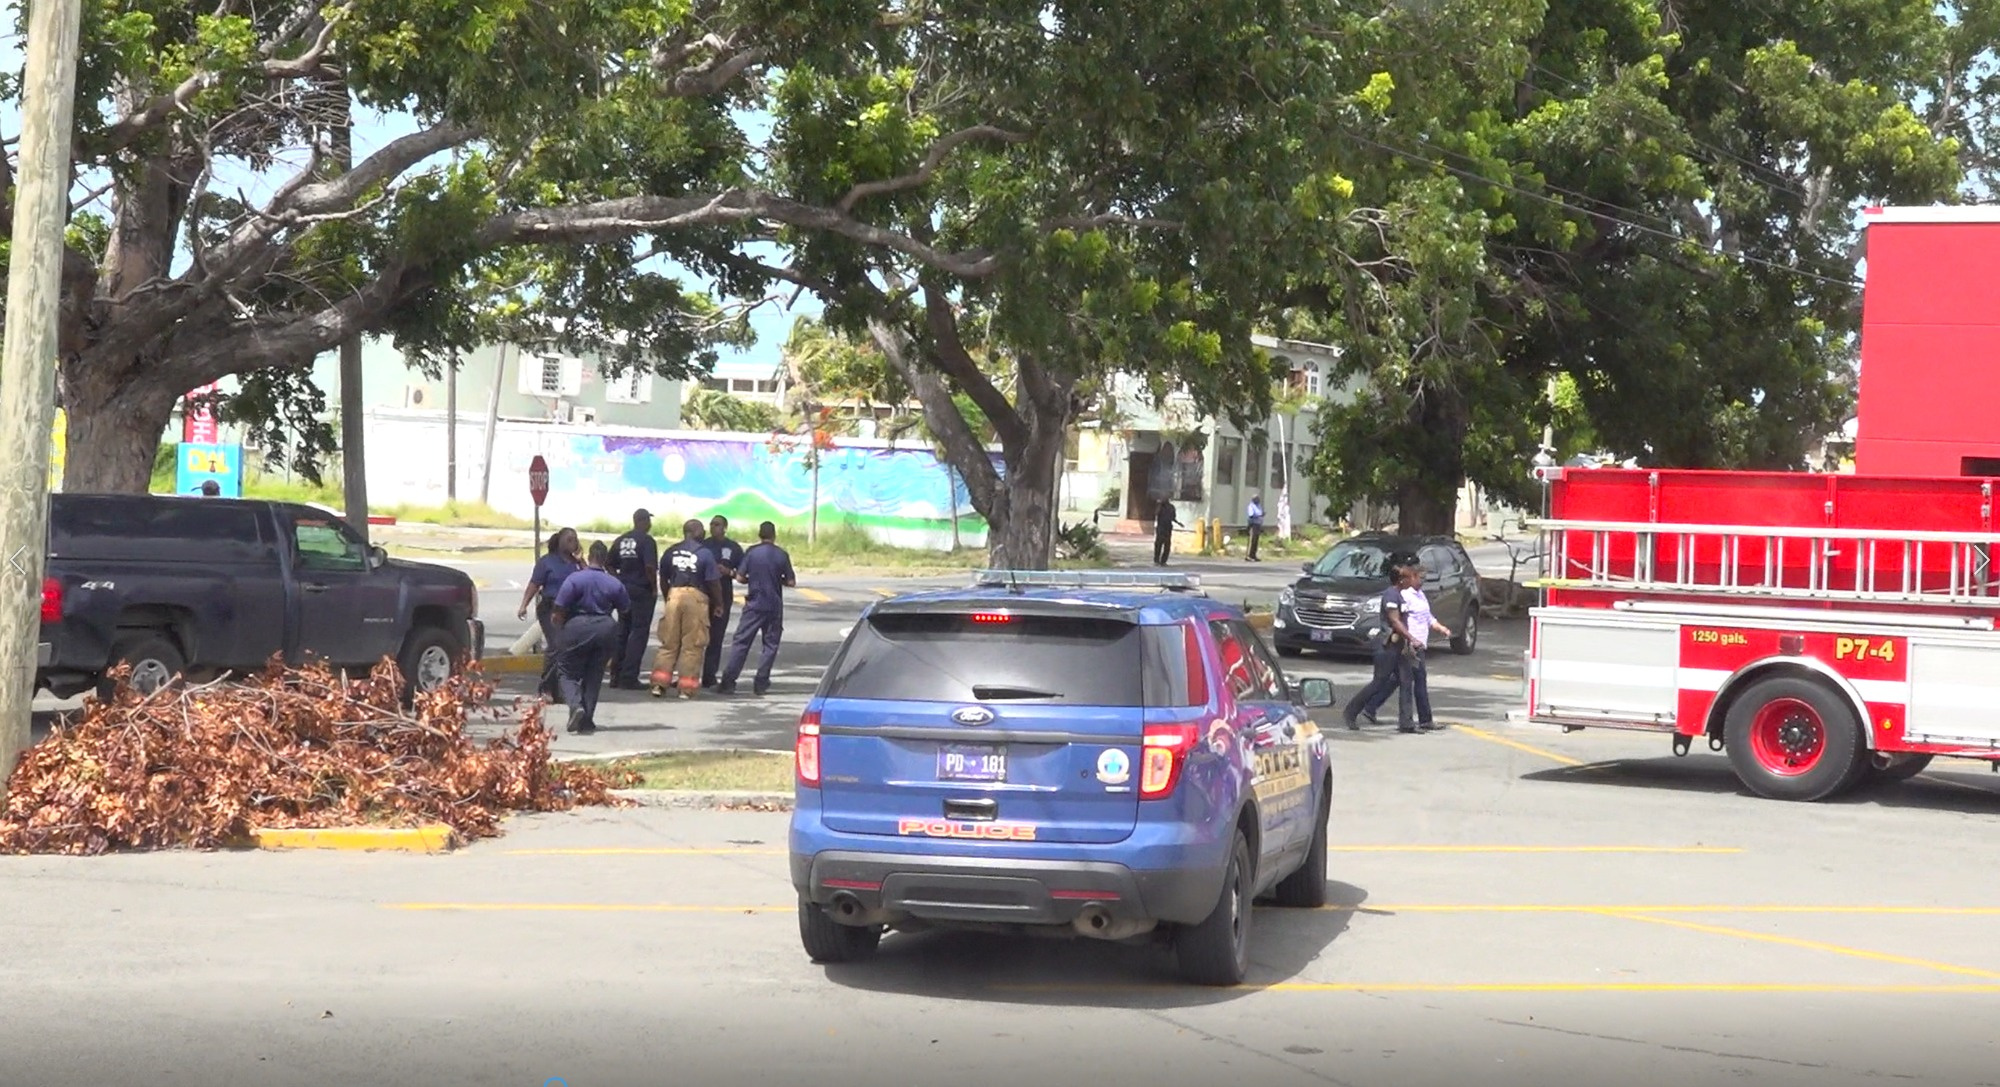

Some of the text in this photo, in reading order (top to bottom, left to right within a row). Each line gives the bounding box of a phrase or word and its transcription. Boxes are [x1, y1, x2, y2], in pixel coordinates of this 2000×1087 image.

[529, 470, 549, 490] STOP
[1692, 630, 1748, 646] 1250 gals.
[1835, 637, 1895, 662] P7-4
[960, 709, 984, 721] Ford
[945, 753, 964, 772] PD
[899, 818, 1037, 840] POLICE
